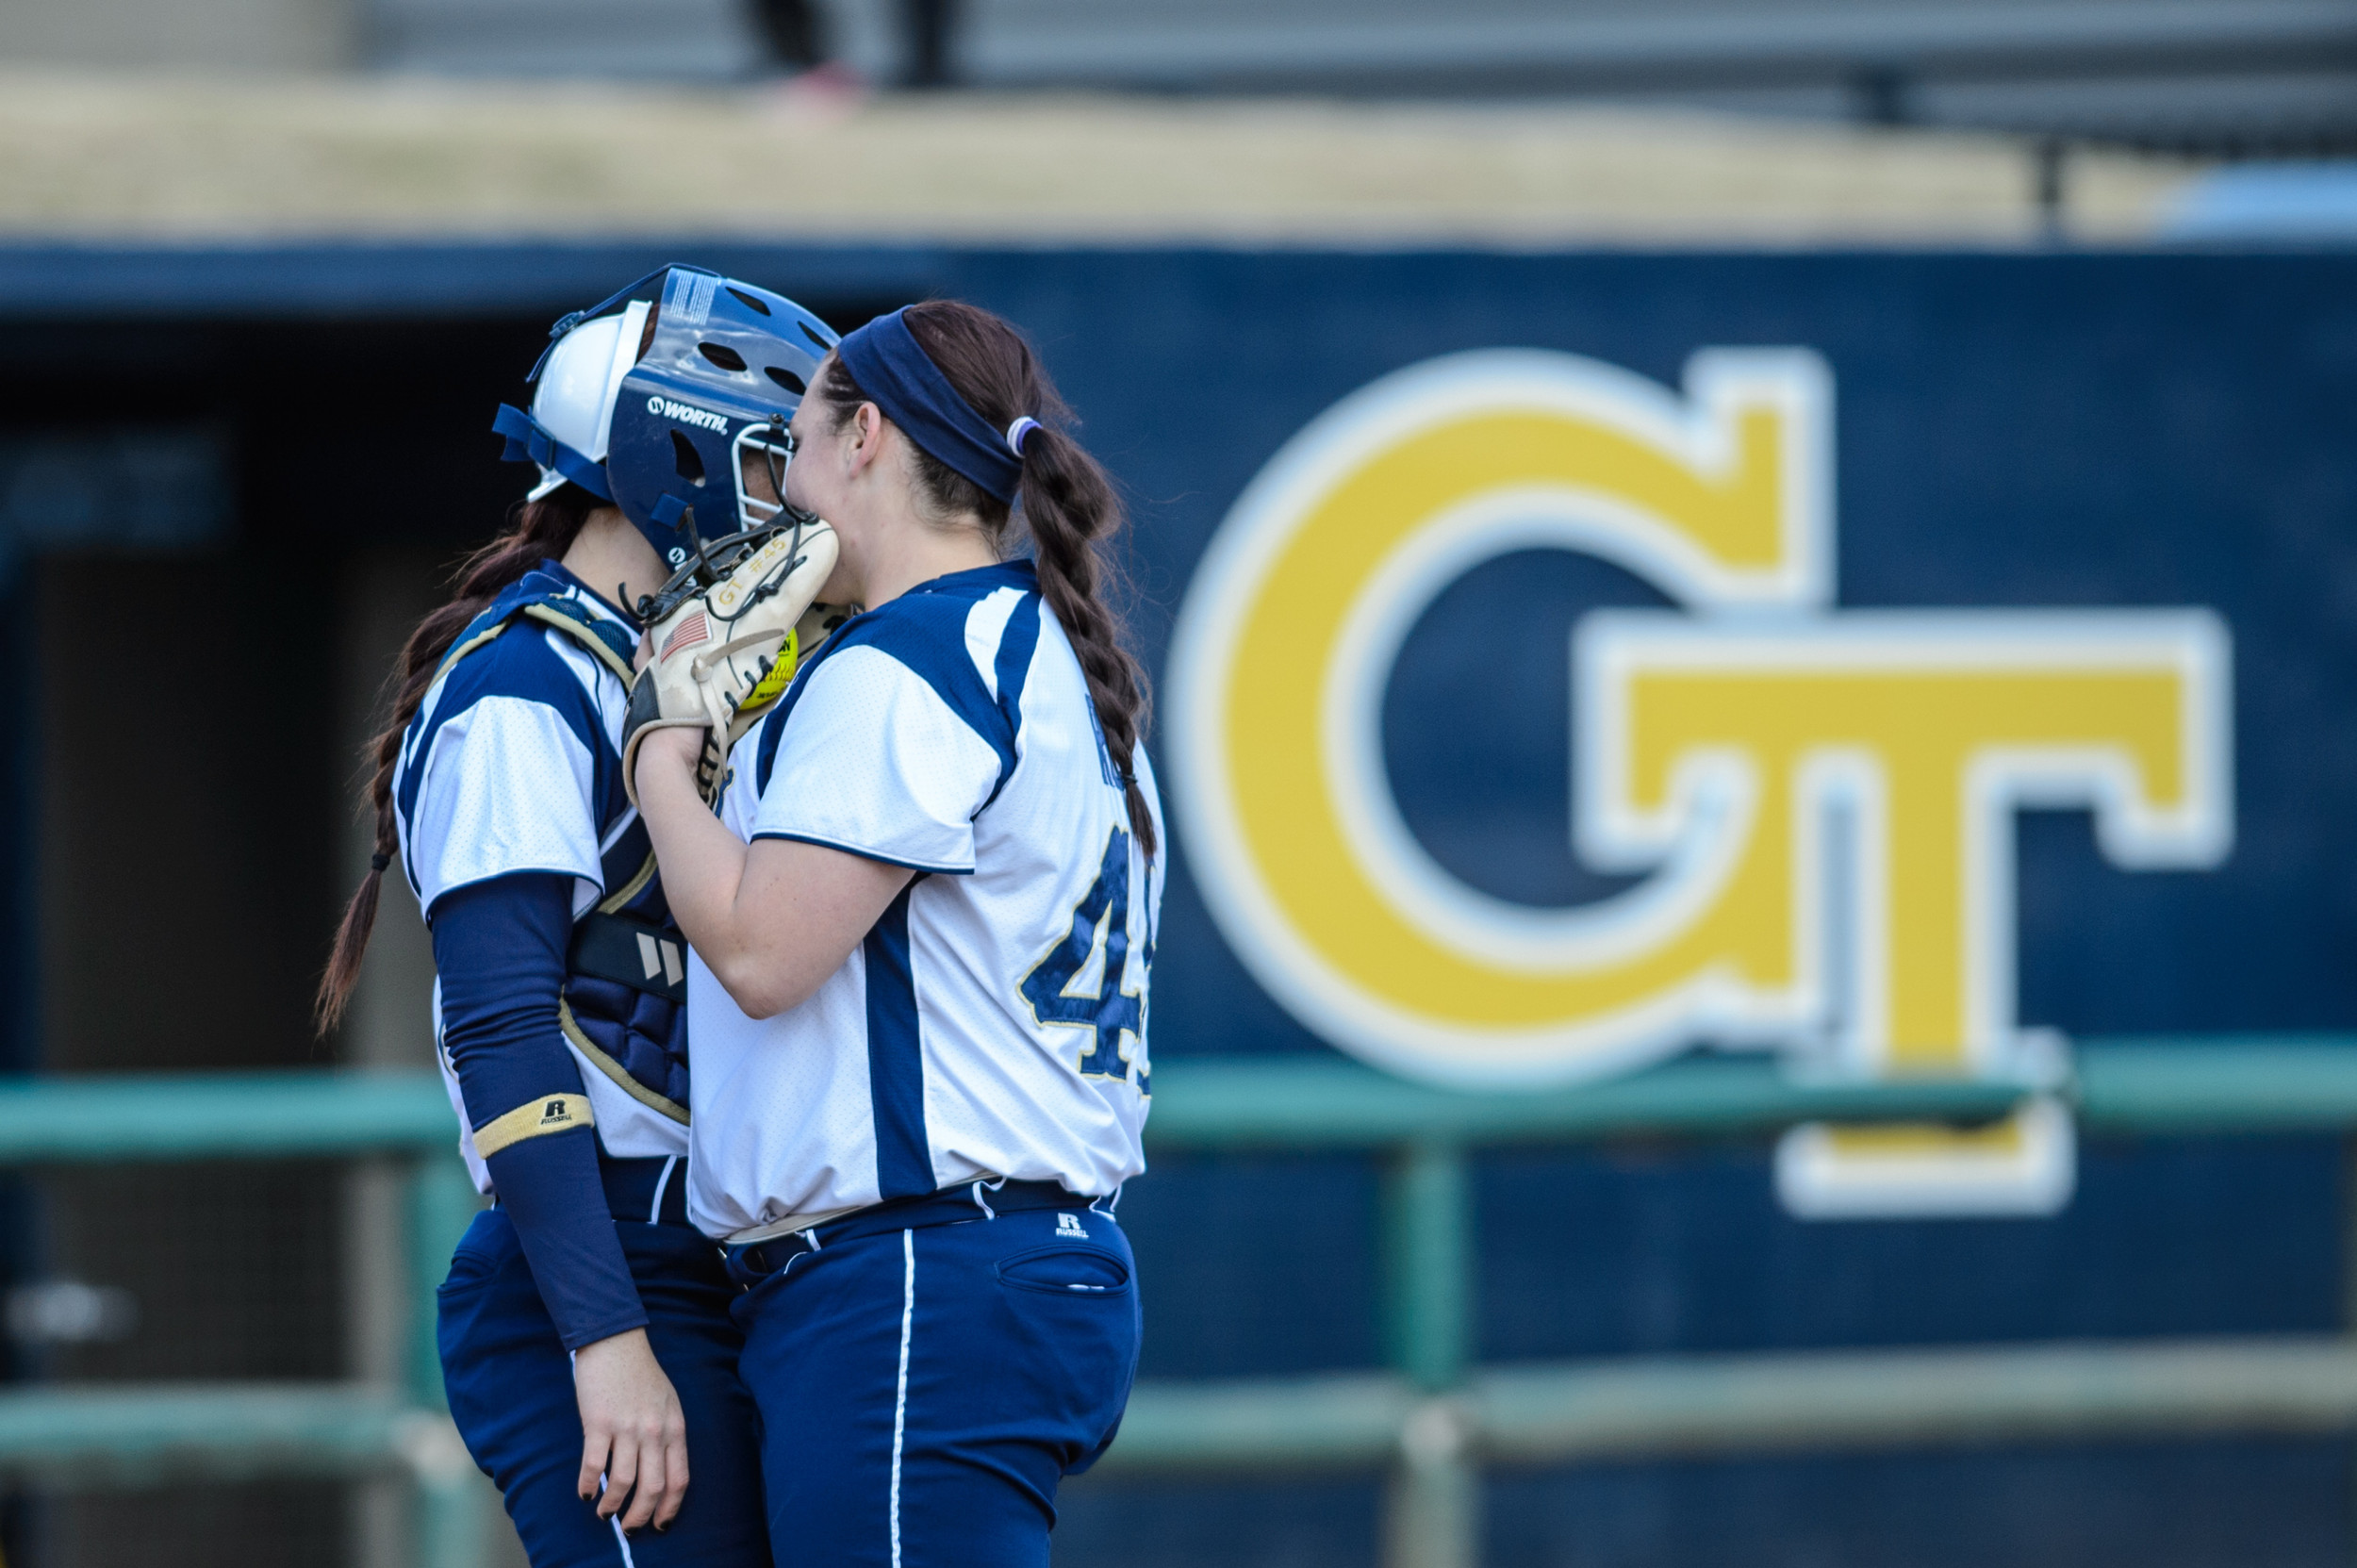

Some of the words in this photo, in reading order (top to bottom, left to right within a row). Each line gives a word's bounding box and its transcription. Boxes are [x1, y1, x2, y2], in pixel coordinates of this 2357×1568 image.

[664, 401, 728, 432] WORTH
[718, 577, 743, 605] GT
[749, 537, 786, 573] #45
[1165, 346, 2236, 1219] GT
[540, 1114, 572, 1125] RUSSELL
[1055, 1228, 1089, 1239] RUSSELL
